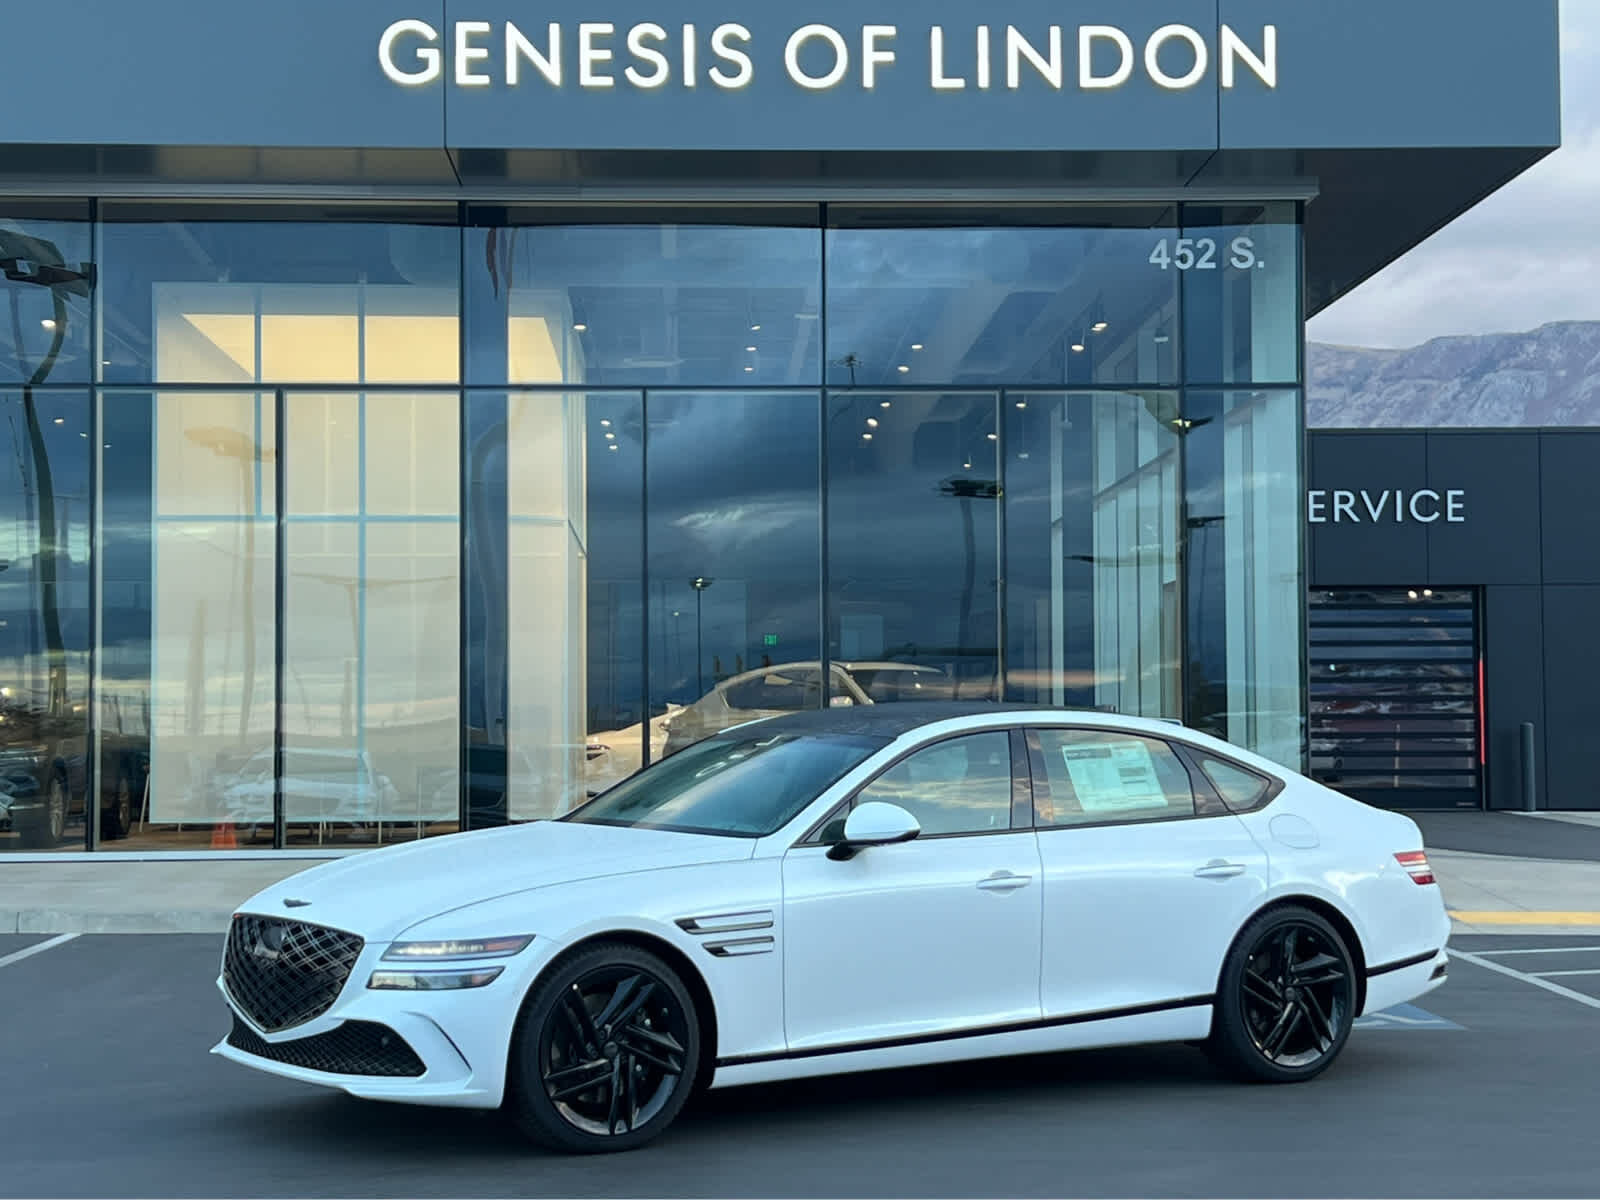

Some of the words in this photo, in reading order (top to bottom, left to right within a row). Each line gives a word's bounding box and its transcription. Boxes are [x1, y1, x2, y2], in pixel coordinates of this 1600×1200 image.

[378, 19, 753, 89] GENESIS
[784, 23, 897, 89] OF
[930, 23, 1277, 89] LINDON
[1148, 237, 1217, 270] 452
[1230, 236, 1265, 269] S.
[1308, 489, 1465, 522] ERVICE
